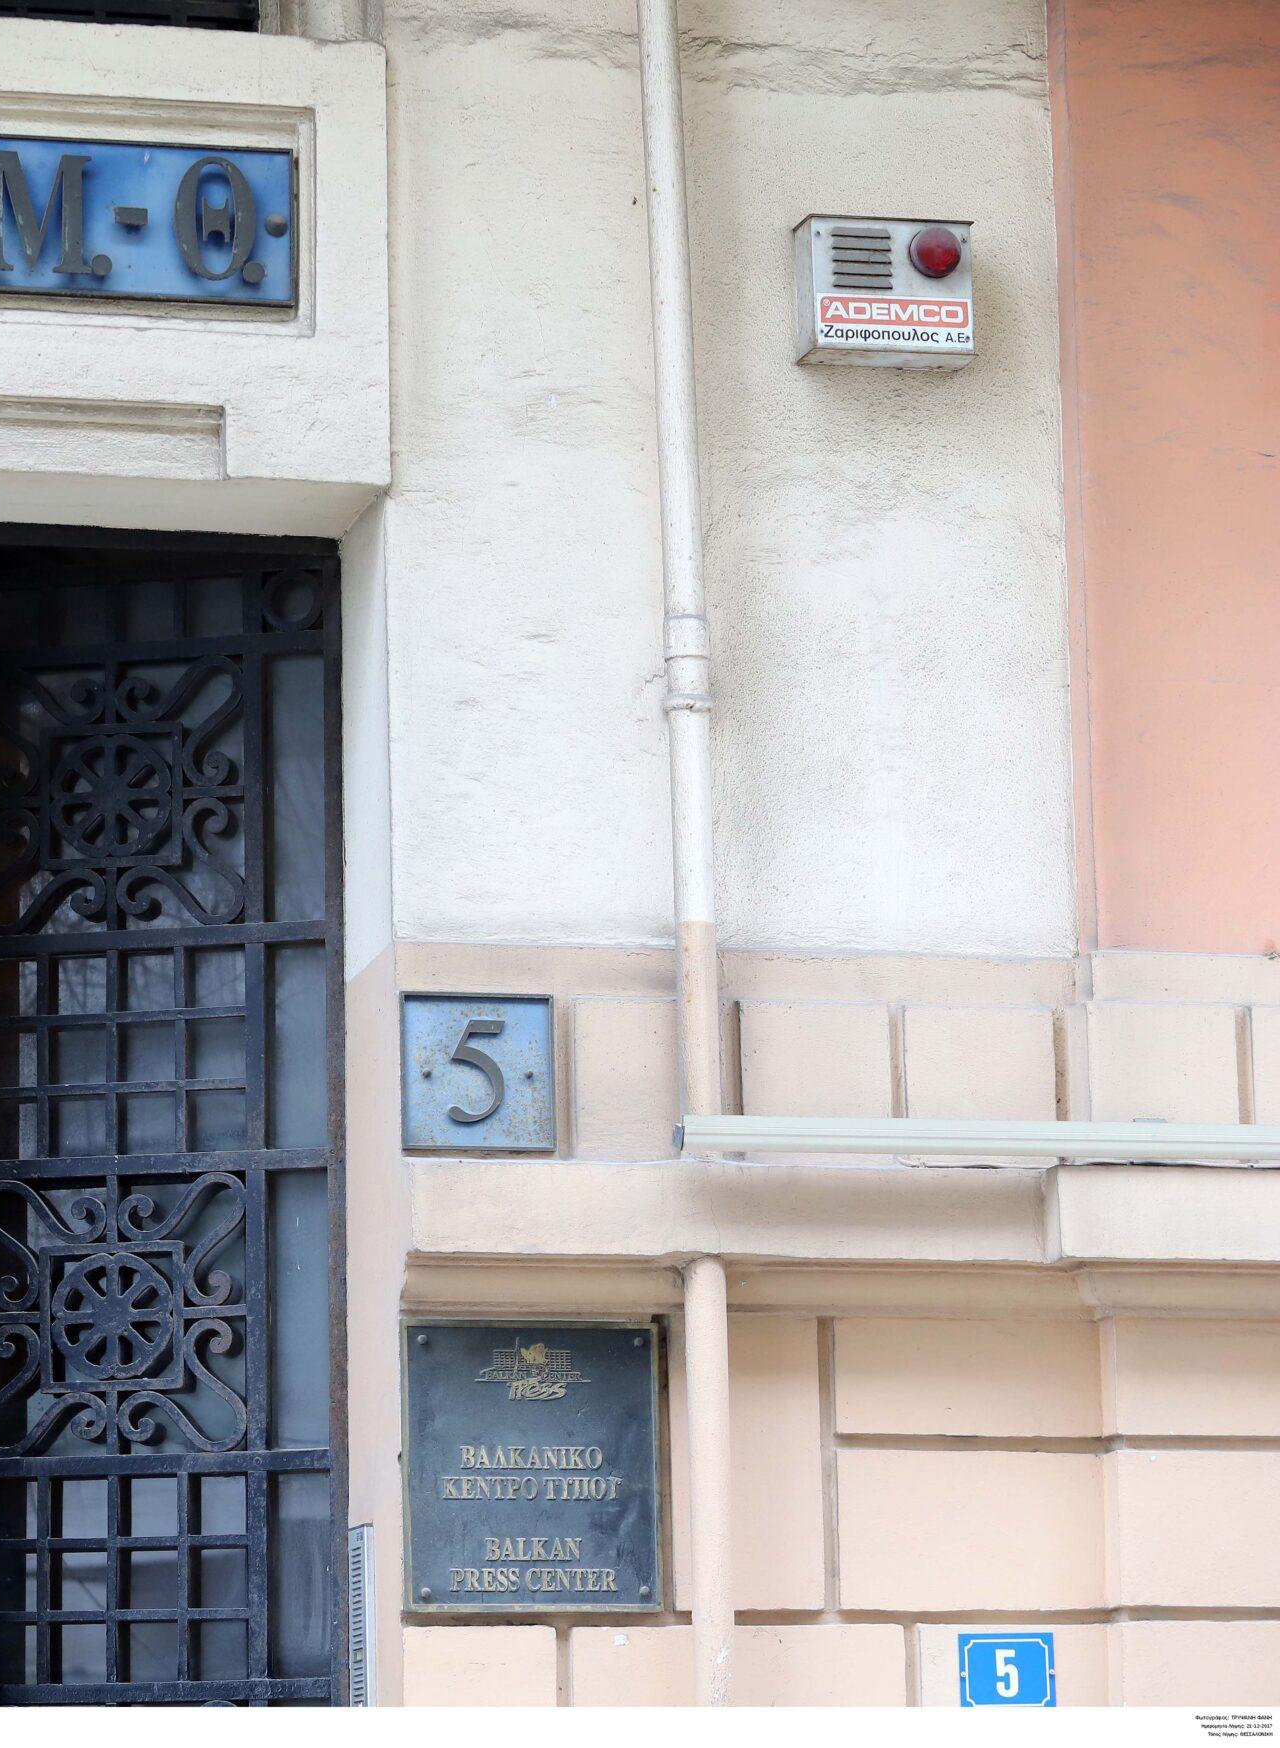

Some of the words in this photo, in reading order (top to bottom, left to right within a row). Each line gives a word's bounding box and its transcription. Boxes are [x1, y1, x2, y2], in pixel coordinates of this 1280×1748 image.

[825, 301, 964, 324] ADEMCO
[823, 324, 939, 344] Ζαριφοπουλος
[448, 1019, 506, 1123] 5
[459, 1445, 604, 1471] ΒΑΛΚΑΝΙΚΟ
[441, 1476, 540, 1501] ΚΕΝΤΡΟ
[485, 1537, 583, 1562] BALKAN
[449, 1567, 520, 1593] PRESS
[526, 1568, 619, 1593] CENTER
[995, 1649, 1019, 1698] 5
